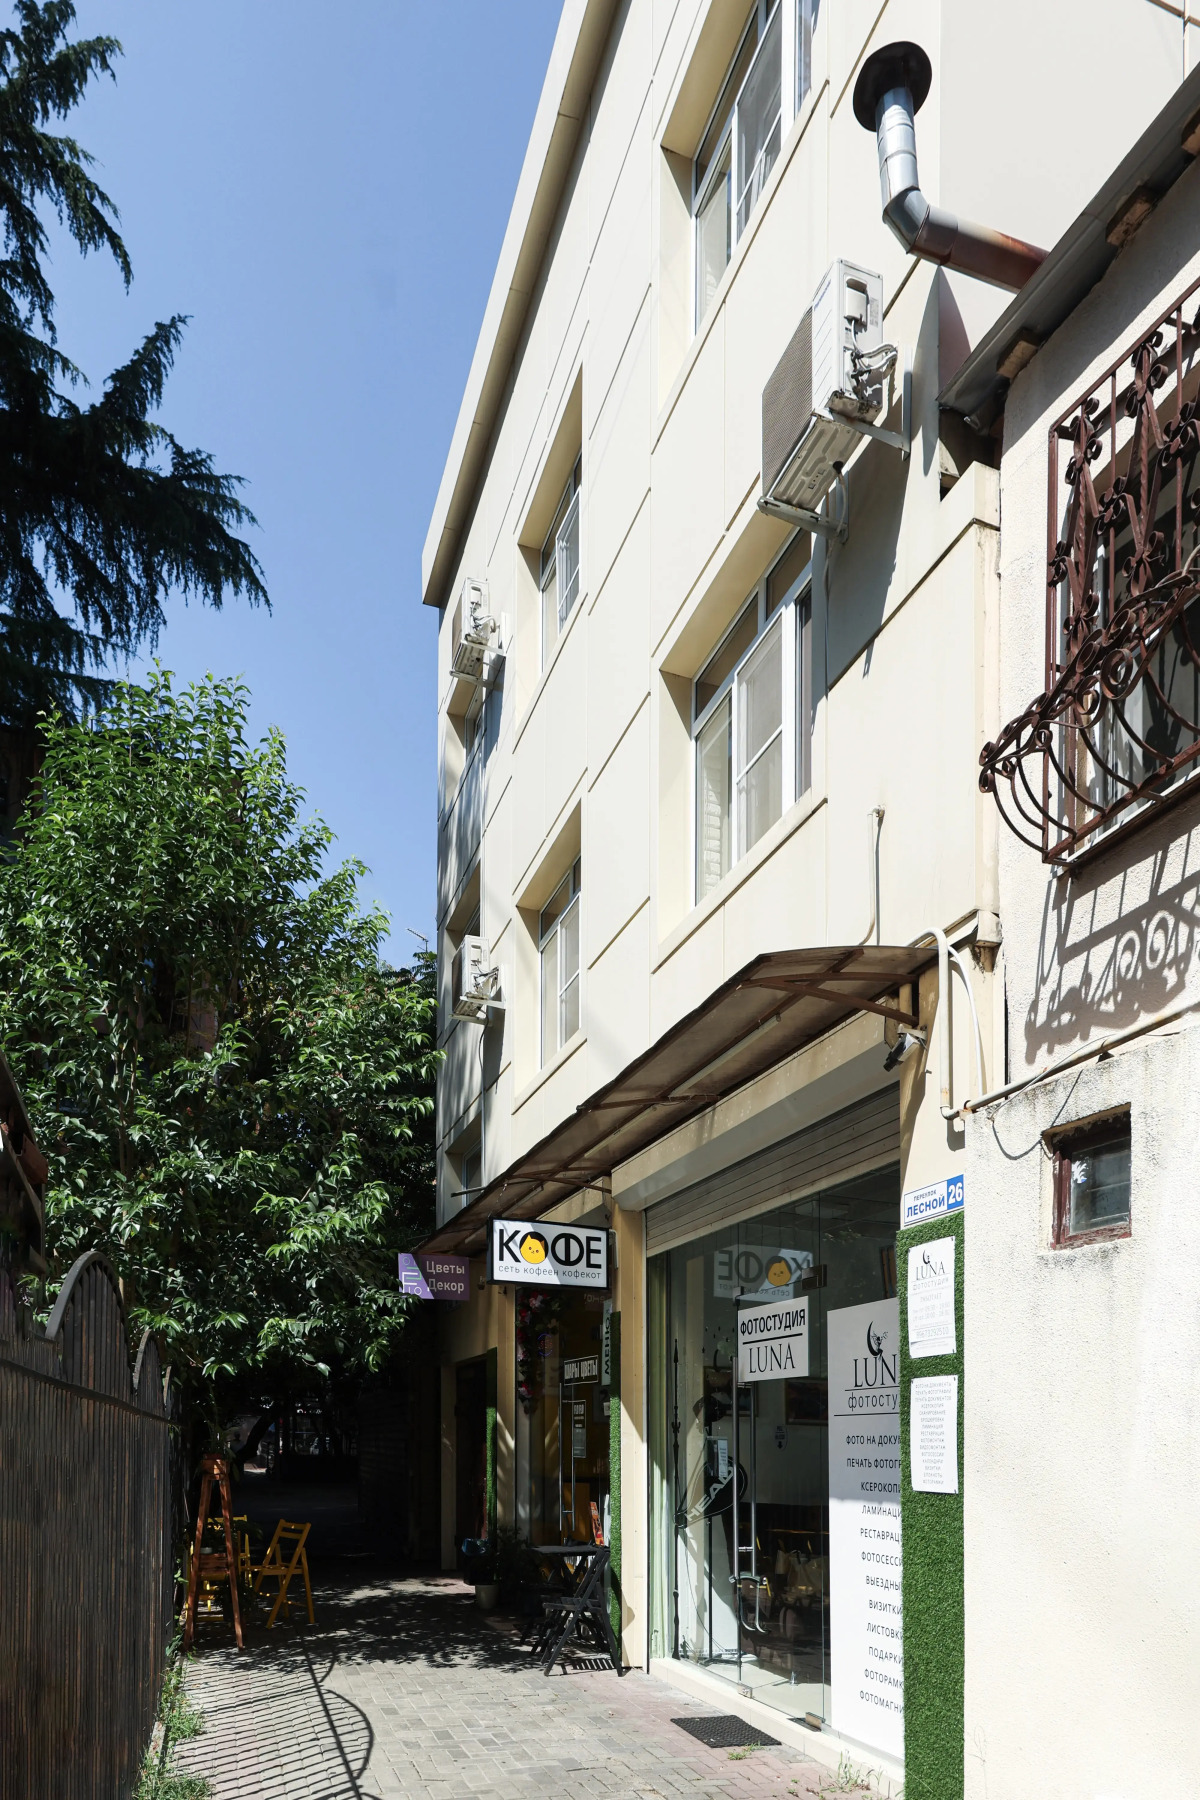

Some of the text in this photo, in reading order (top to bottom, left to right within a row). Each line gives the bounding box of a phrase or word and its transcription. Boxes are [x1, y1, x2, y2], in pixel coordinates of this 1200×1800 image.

[906, 1182, 963, 1218] ЛЕСНОЙ 26
[913, 1189, 937, 1201] ПЕРЕУЛОК
[498, 1228, 602, 1270] КОФЕ
[426, 1260, 465, 1275] Цветы
[498, 1265, 602, 1279] сеть кофеен кофекот
[915, 1260, 946, 1281] LUNA
[427, 1278, 465, 1294] Декор
[740, 1308, 806, 1337] ФОТОСТУДИЯ
[748, 1342, 796, 1374] LUNA
[853, 1353, 900, 1388] LUN
[848, 1391, 900, 1412] фотосту
[846, 1434, 865, 1446] ФОТО
[866, 1435, 877, 1445] НА
[846, 1457, 872, 1469] ПЕЧАТЬ
[868, 1599, 902, 1615] ВИЗИТКИ
[868, 1646, 903, 1665] ПОДАРКИ
